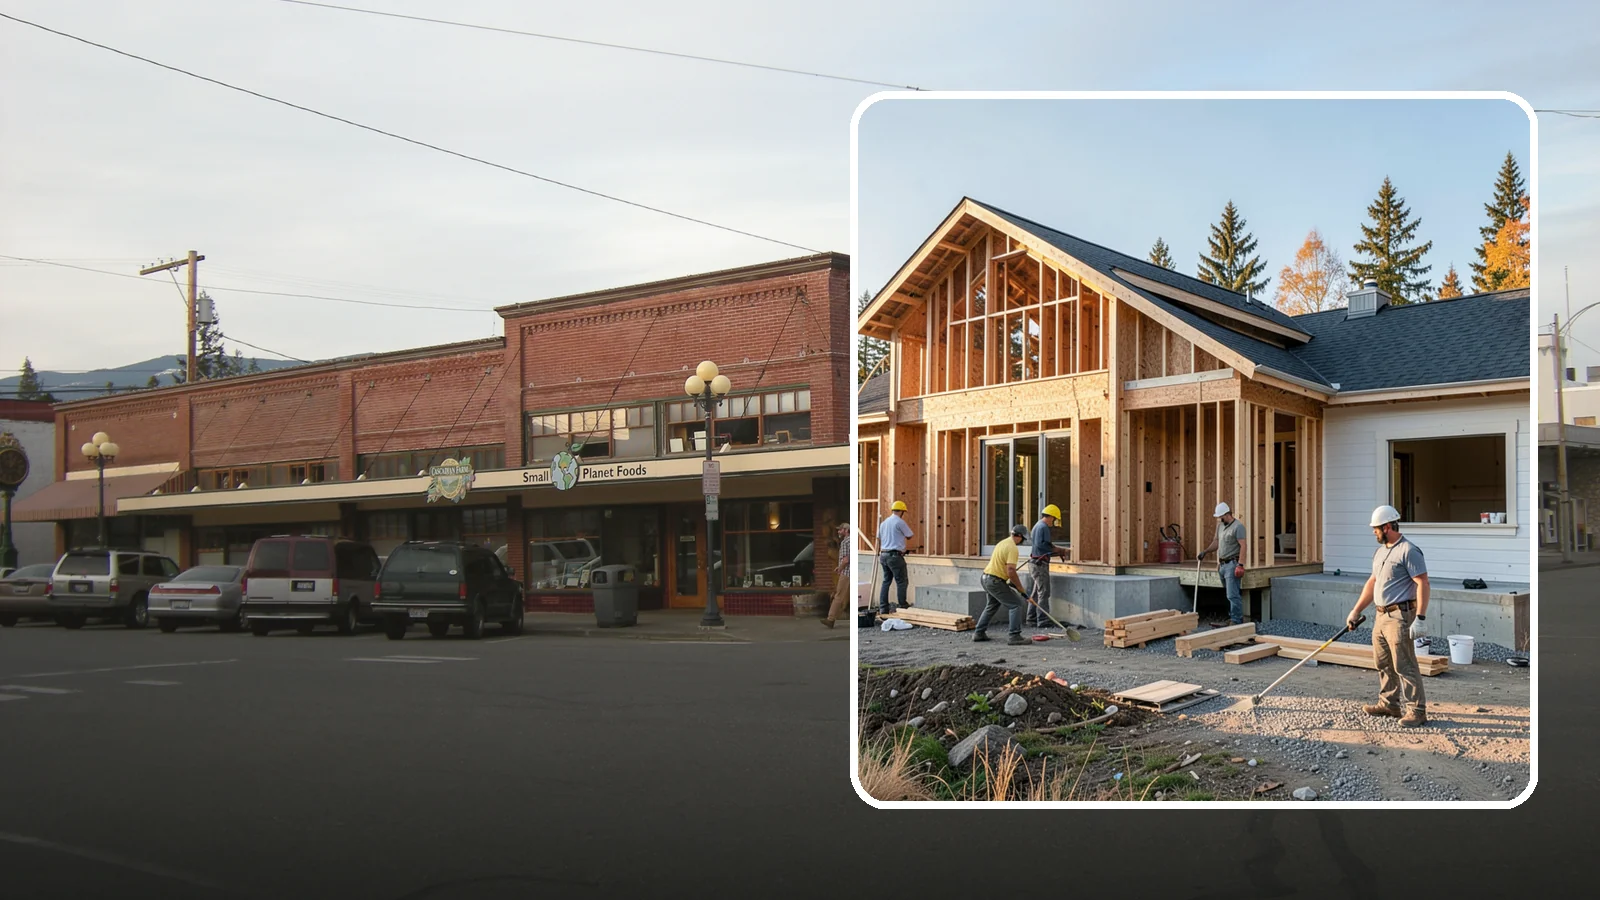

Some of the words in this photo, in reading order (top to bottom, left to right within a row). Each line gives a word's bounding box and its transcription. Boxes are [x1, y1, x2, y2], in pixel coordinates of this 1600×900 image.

[523, 470, 549, 483] Small
[583, 468, 614, 479] Planet
[617, 464, 647, 477] Foods
